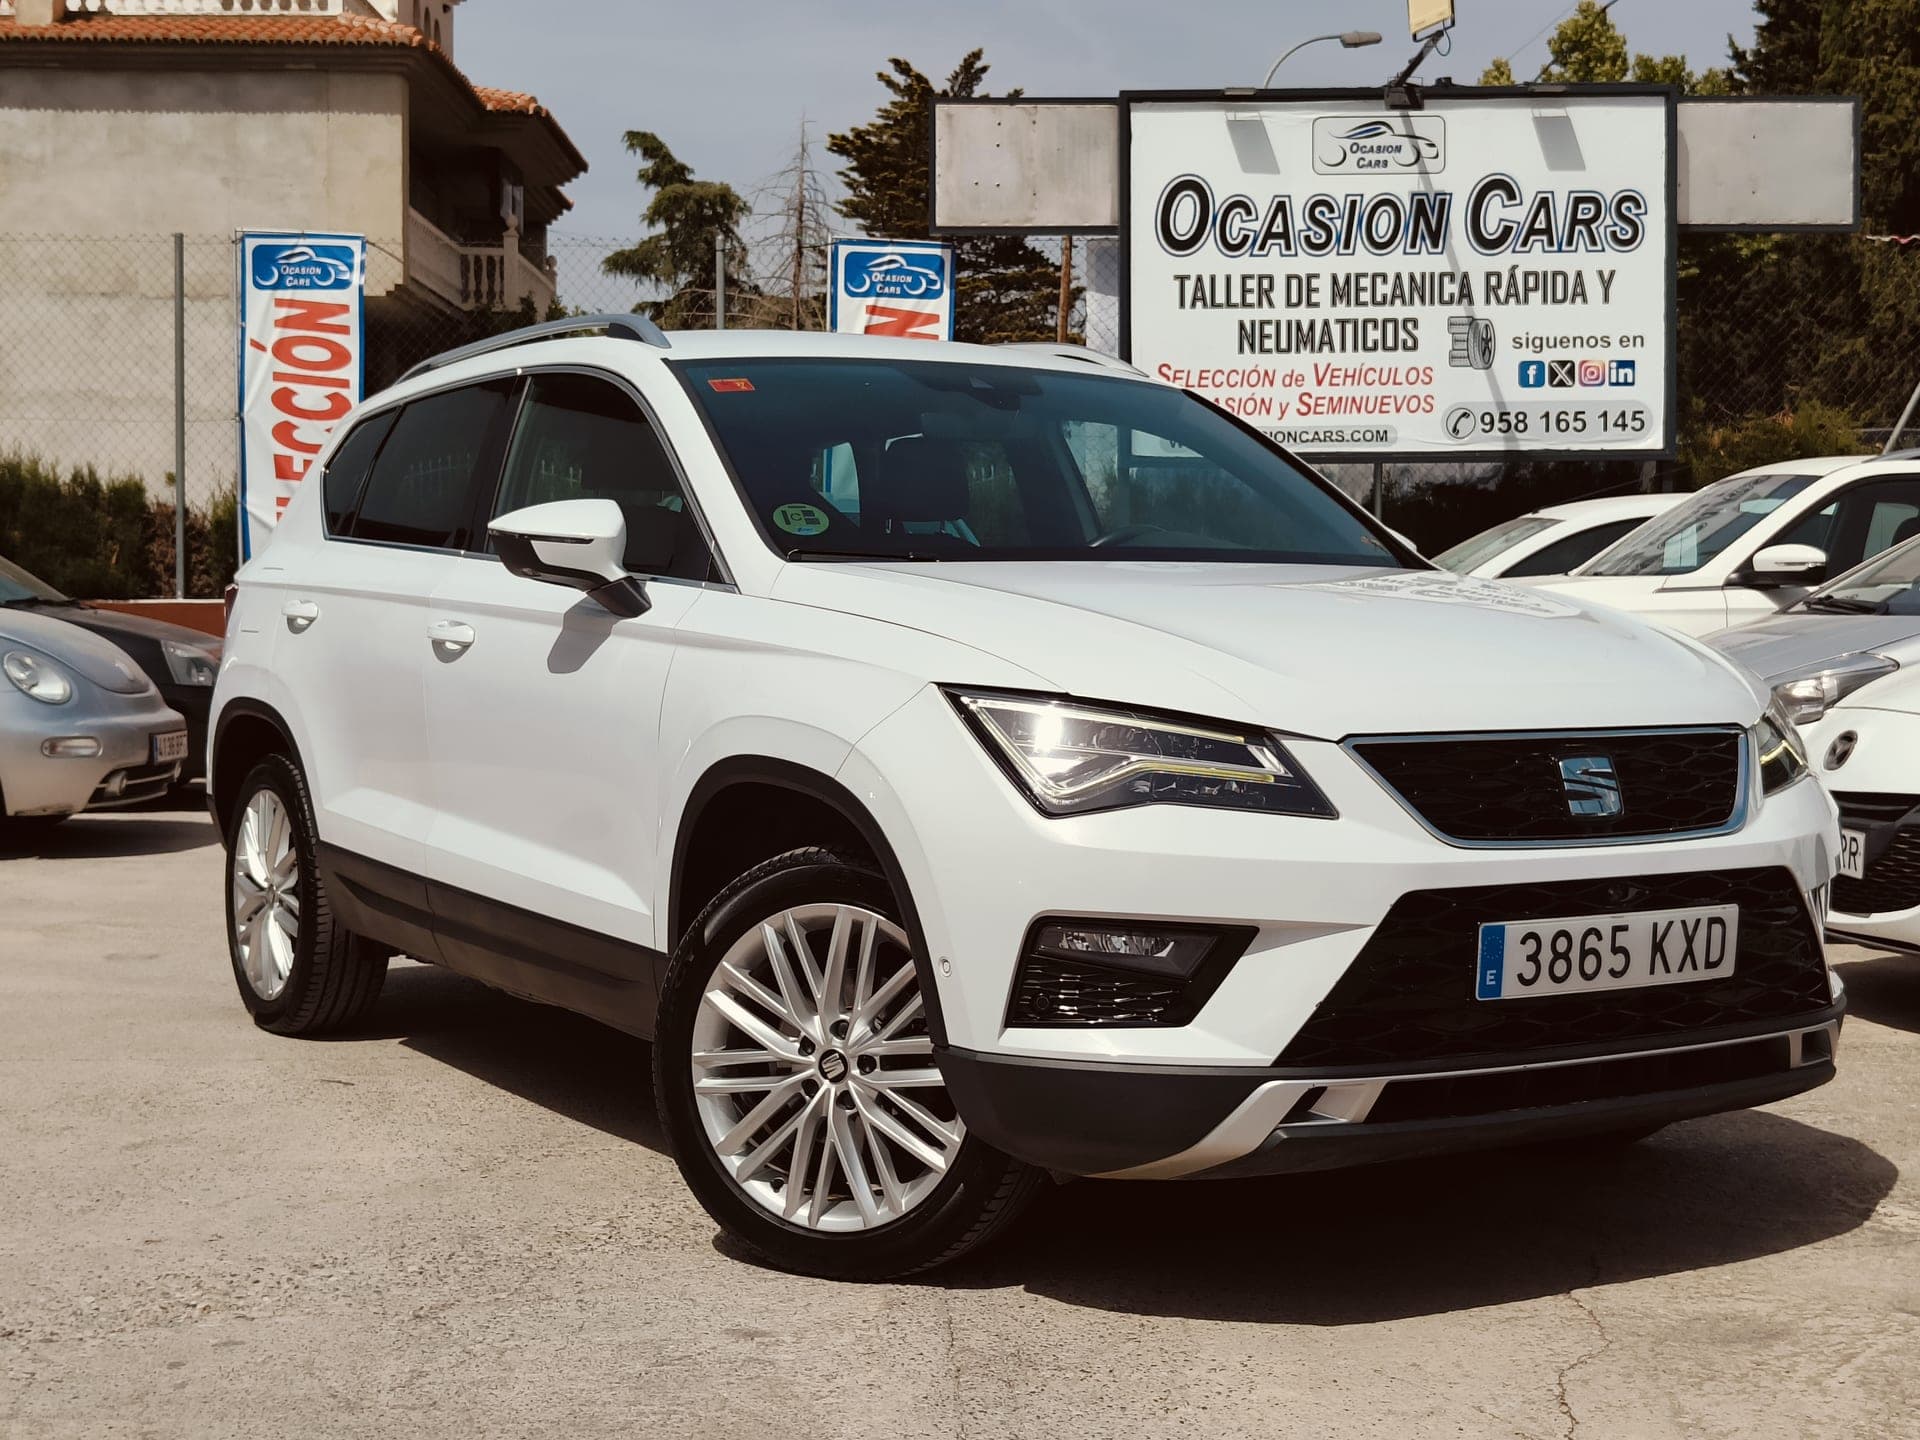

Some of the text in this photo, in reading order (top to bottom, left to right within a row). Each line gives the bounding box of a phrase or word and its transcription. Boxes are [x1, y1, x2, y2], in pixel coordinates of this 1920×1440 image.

[1349, 142, 1402, 154] OCASION
[1356, 157, 1388, 169] CARS
[1155, 172, 1648, 257] OCASION CARS
[281, 264, 322, 275] OCASION
[871, 271, 913, 283] OCASION
[286, 276, 310, 287] CARS
[876, 283, 902, 295] CARS
[1174, 264, 1617, 310] TALLER DE MECANICA RÁPIDA Y
[1237, 317, 1419, 355] NEUMATICOS
[1511, 331, 1645, 354] siguenos en
[1157, 362, 1433, 388] SELECCIÓN de VEHÍCULOS
[1214, 391, 1435, 421] SIÓN y SEMINUEVOS
[1479, 409, 1645, 434] 958 165 145
[1516, 916, 1727, 987] 3865 KXD
[1485, 970, 1497, 986] E
